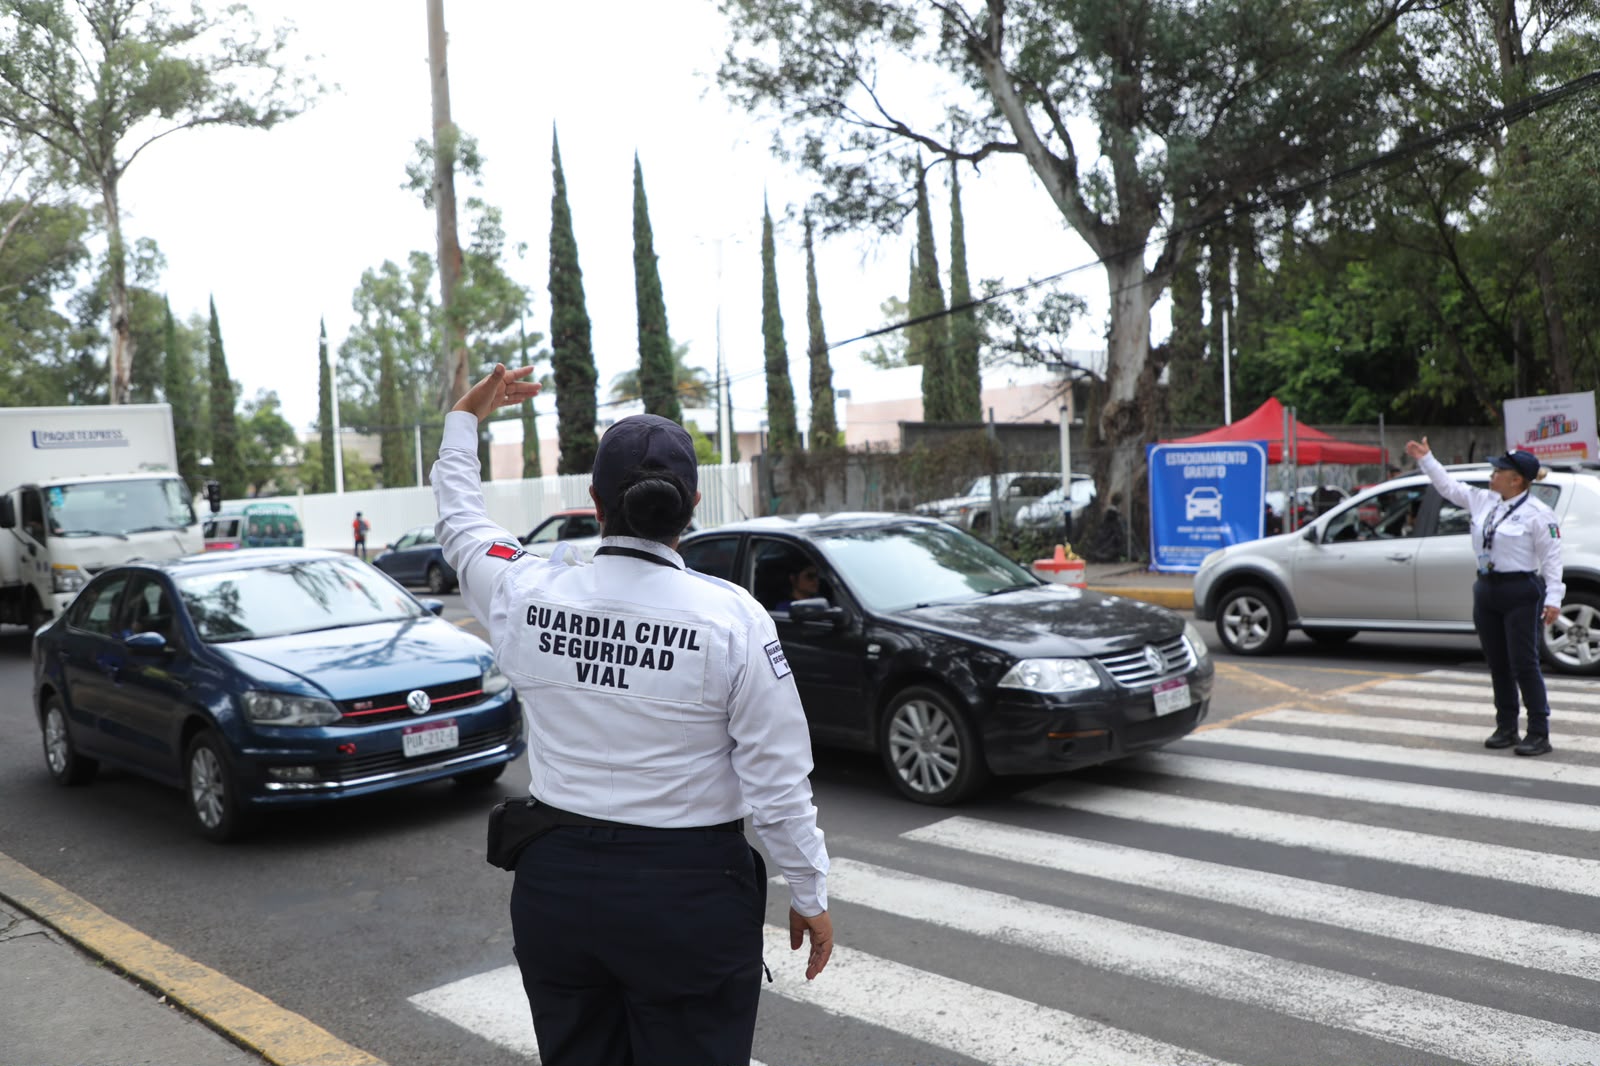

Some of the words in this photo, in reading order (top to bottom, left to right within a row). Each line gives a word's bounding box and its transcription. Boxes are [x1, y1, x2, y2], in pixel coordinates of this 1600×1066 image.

[42, 429, 123, 441] PAQUETEXPRESS
[1165, 451, 1248, 466] ESTACIONAMIENTO
[1183, 465, 1226, 479] GRATUITO
[526, 604, 626, 641] GUARDIA
[634, 622, 701, 651] CIVIL
[538, 632, 675, 672] SEGURIDAD
[575, 661, 630, 690] VIAL
